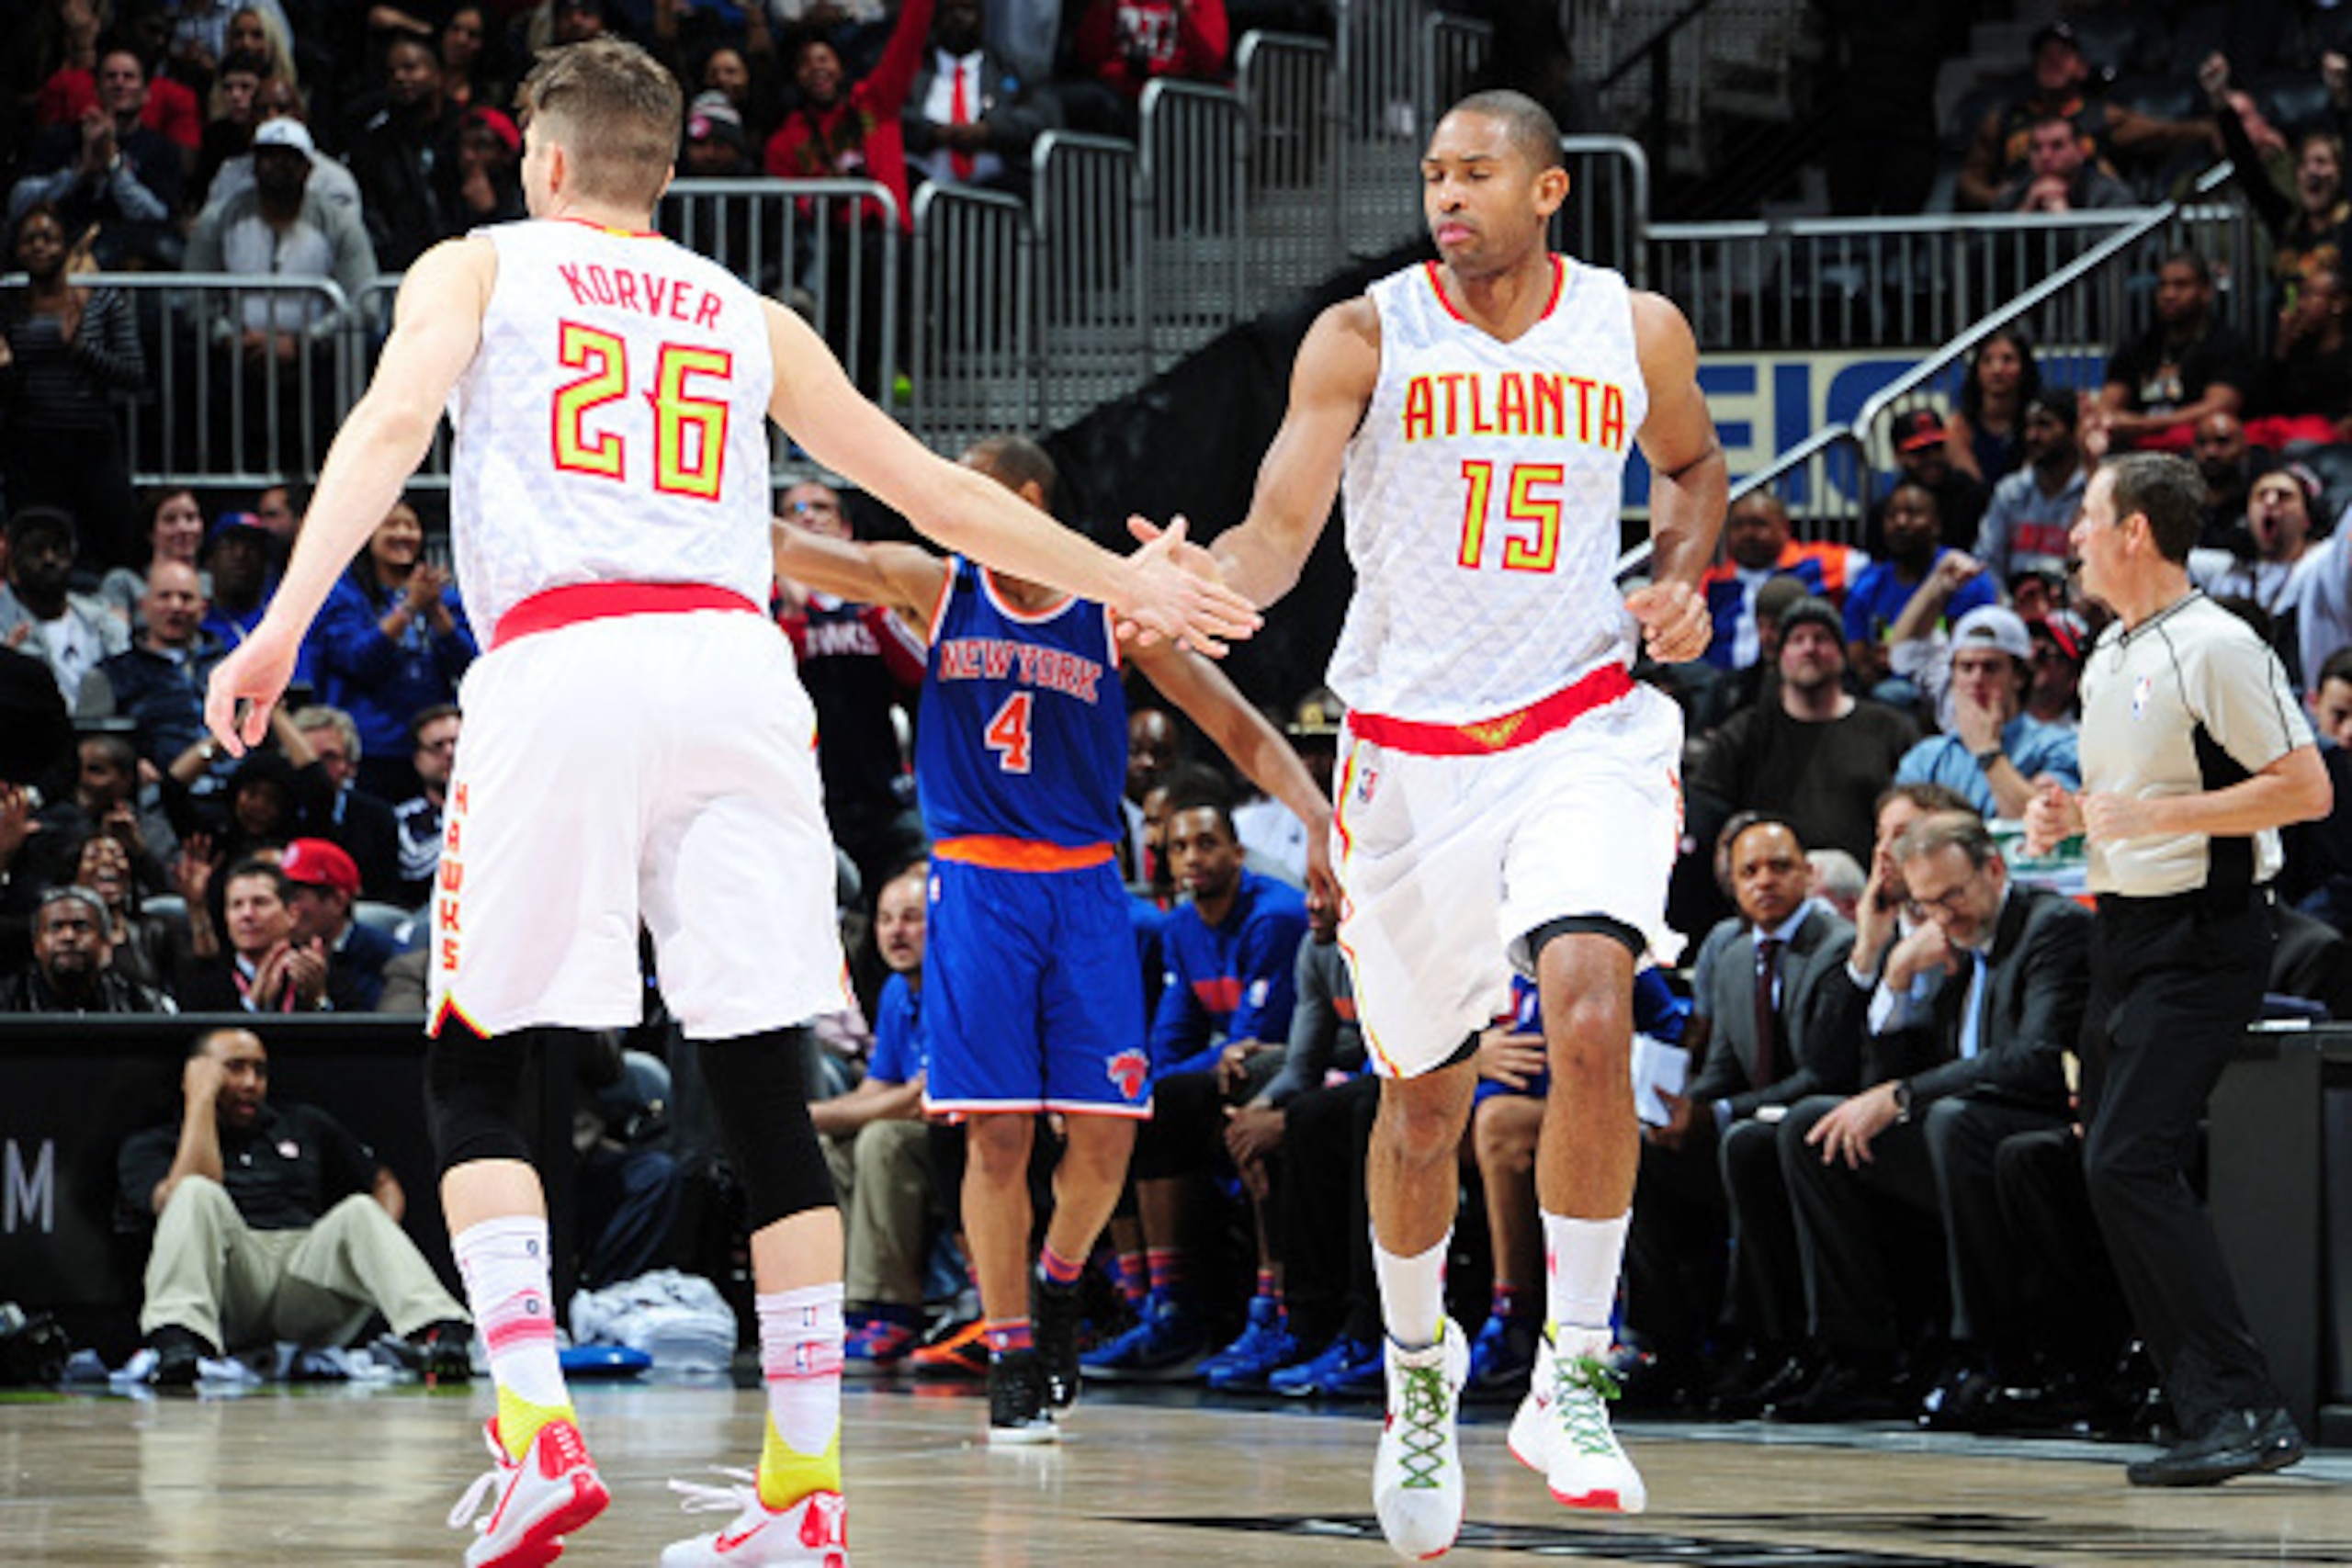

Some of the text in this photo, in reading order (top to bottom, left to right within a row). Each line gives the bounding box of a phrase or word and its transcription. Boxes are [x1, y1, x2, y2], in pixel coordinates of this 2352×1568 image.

[558, 262, 722, 331] KORVER
[550, 317, 732, 502] 26
[1402, 371, 1626, 454] ATLANTA
[1457, 458, 1565, 574] 15
[938, 637, 1102, 706] NEW YORK
[984, 690, 1034, 773] 4
[439, 781, 469, 971] HAWKS
